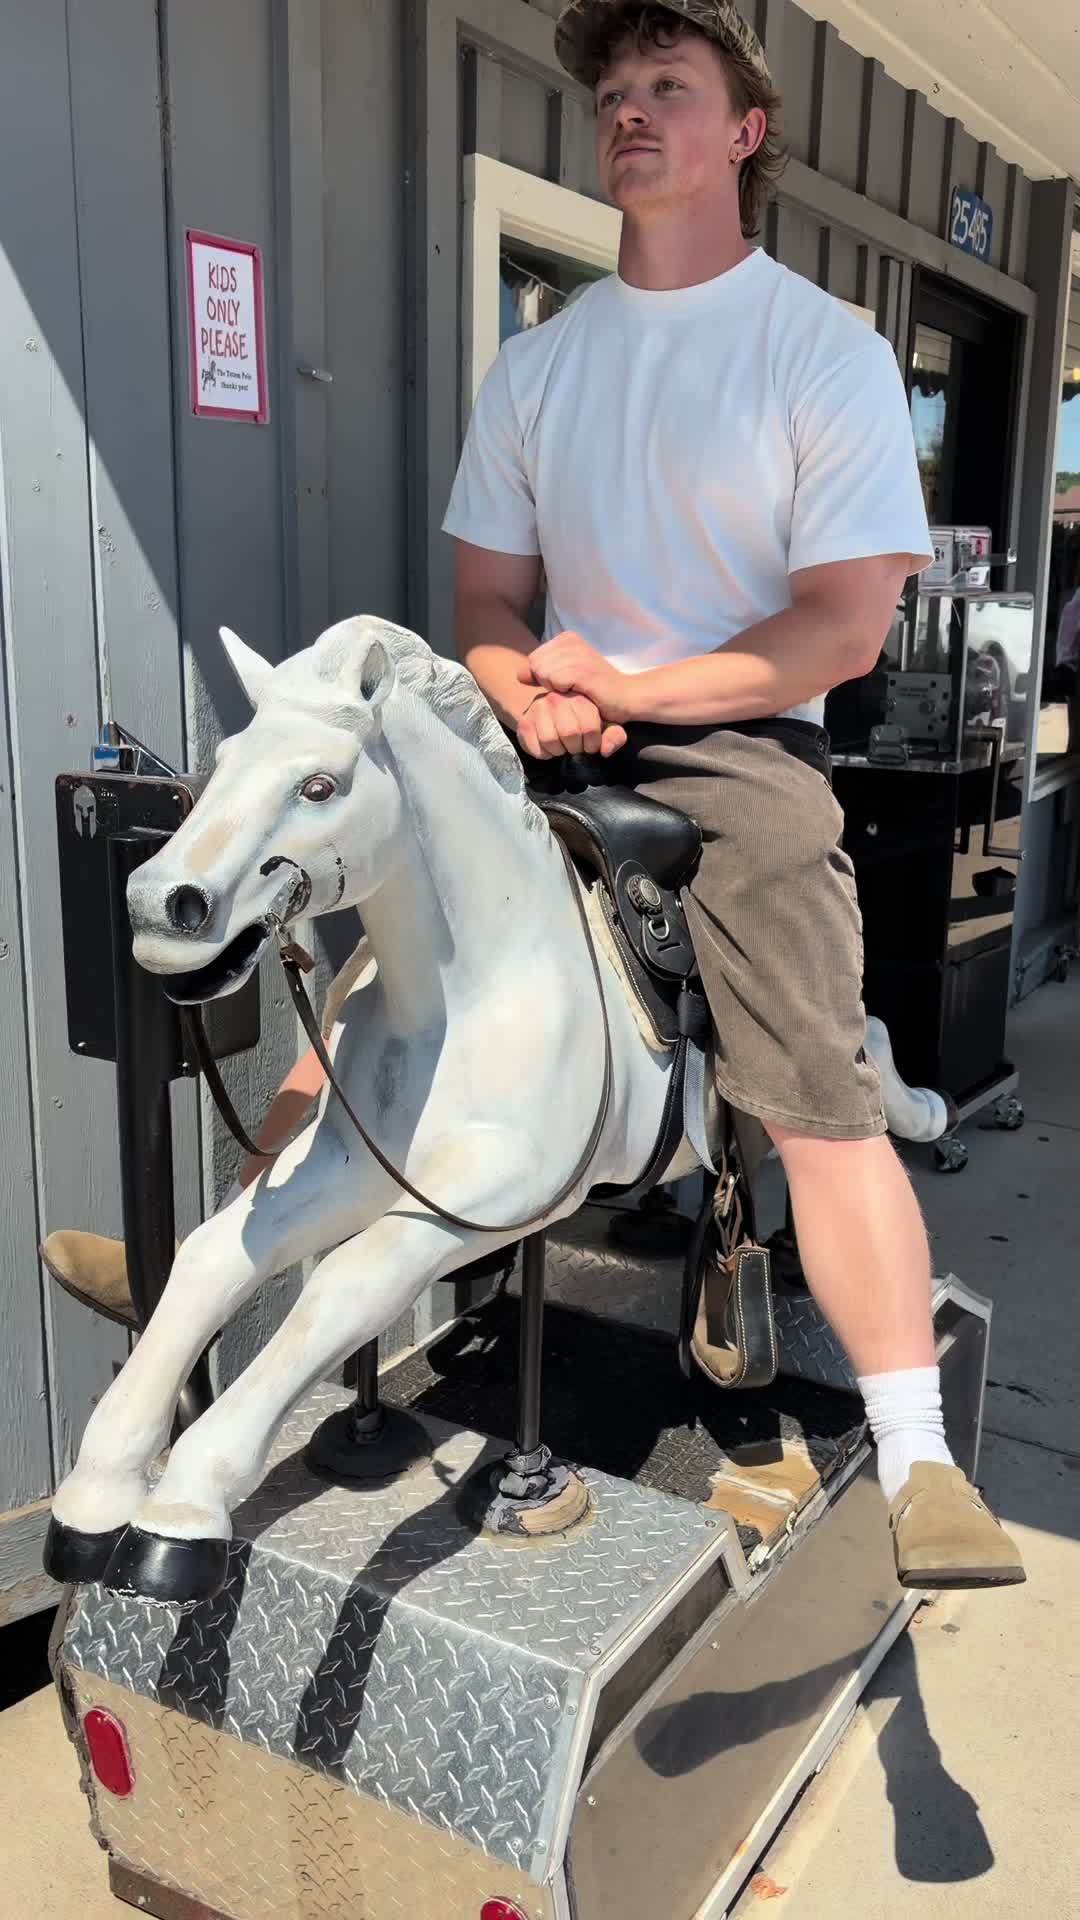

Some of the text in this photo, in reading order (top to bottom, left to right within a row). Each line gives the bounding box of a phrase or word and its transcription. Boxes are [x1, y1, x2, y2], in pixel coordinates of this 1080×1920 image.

[951, 196, 989, 255] 25485
[208, 261, 237, 293] KIDS
[206, 296, 241, 327] ONLY
[201, 327, 248, 360] PLEASE
[217, 368, 226, 377] The
